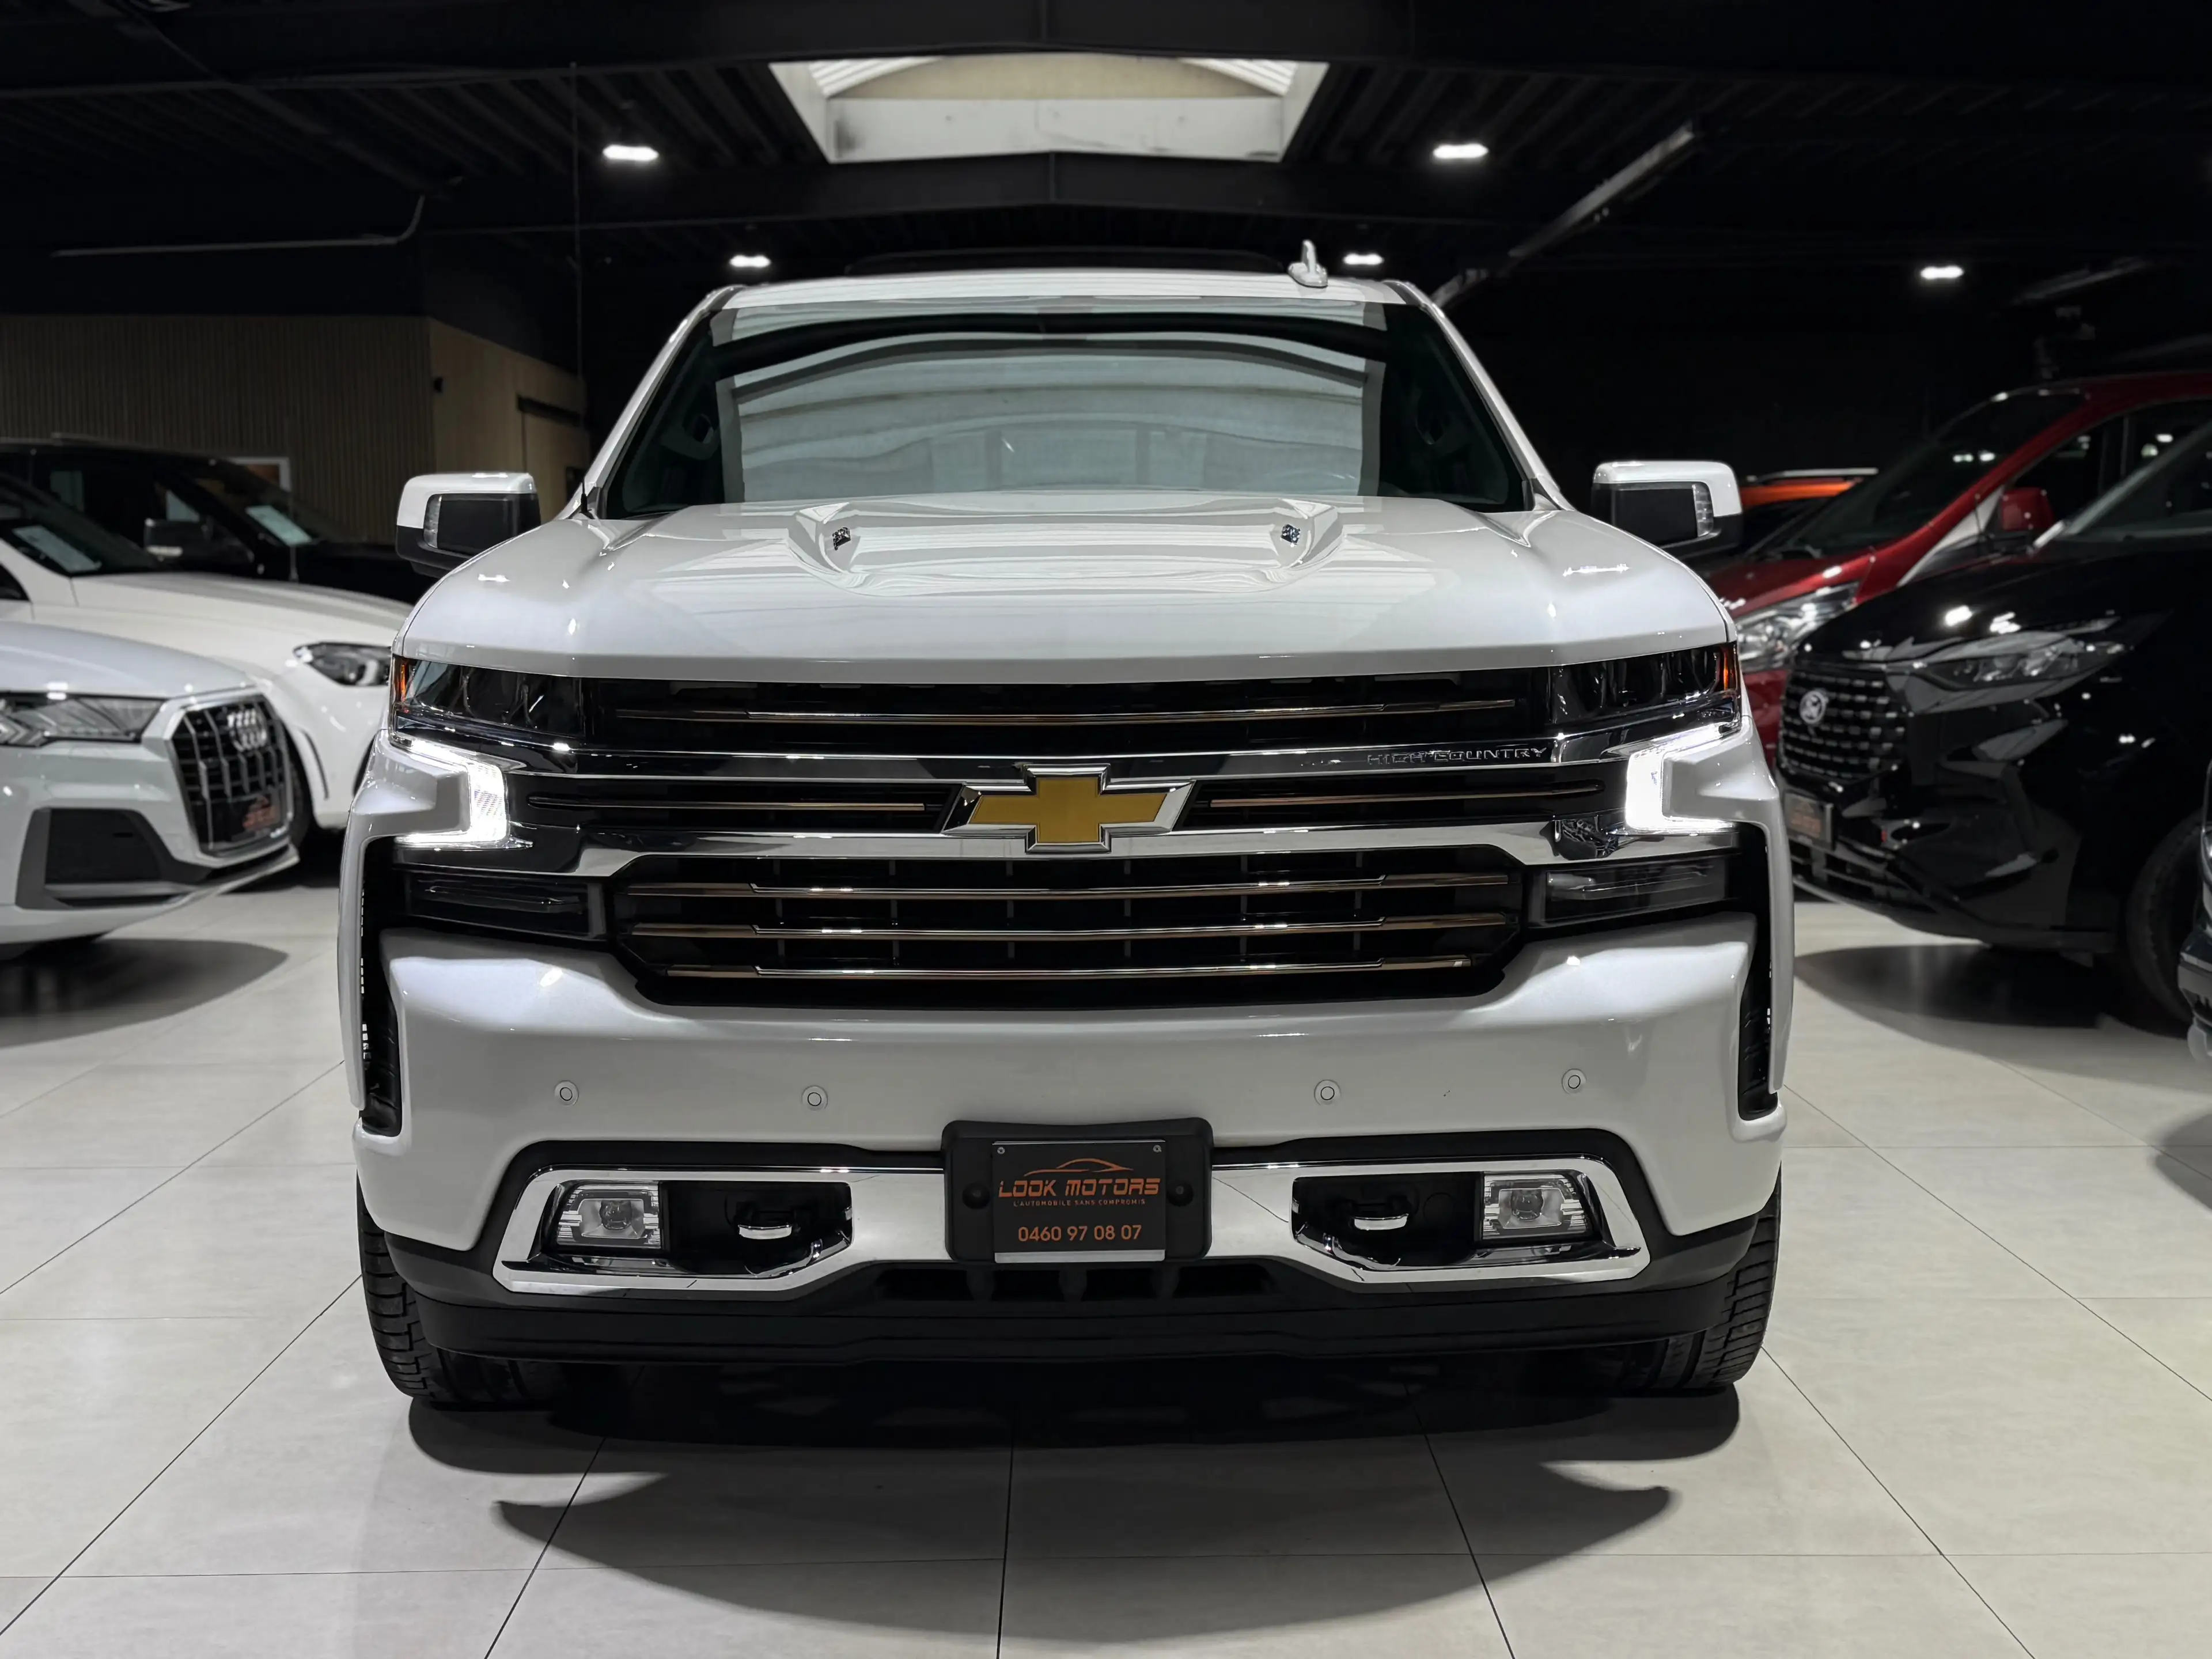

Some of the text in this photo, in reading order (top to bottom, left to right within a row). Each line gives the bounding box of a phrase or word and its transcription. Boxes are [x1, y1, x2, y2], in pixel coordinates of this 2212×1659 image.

[1433, 747, 1547, 762] COUNTRY
[998, 1178, 1161, 1198] LOOK MOTORS
[1013, 1199, 1071, 1207] L'AUTOMOBILE
[1098, 1198, 1146, 1206] COMPROMIS
[1018, 1224, 1142, 1242] 0460 97 08 07
